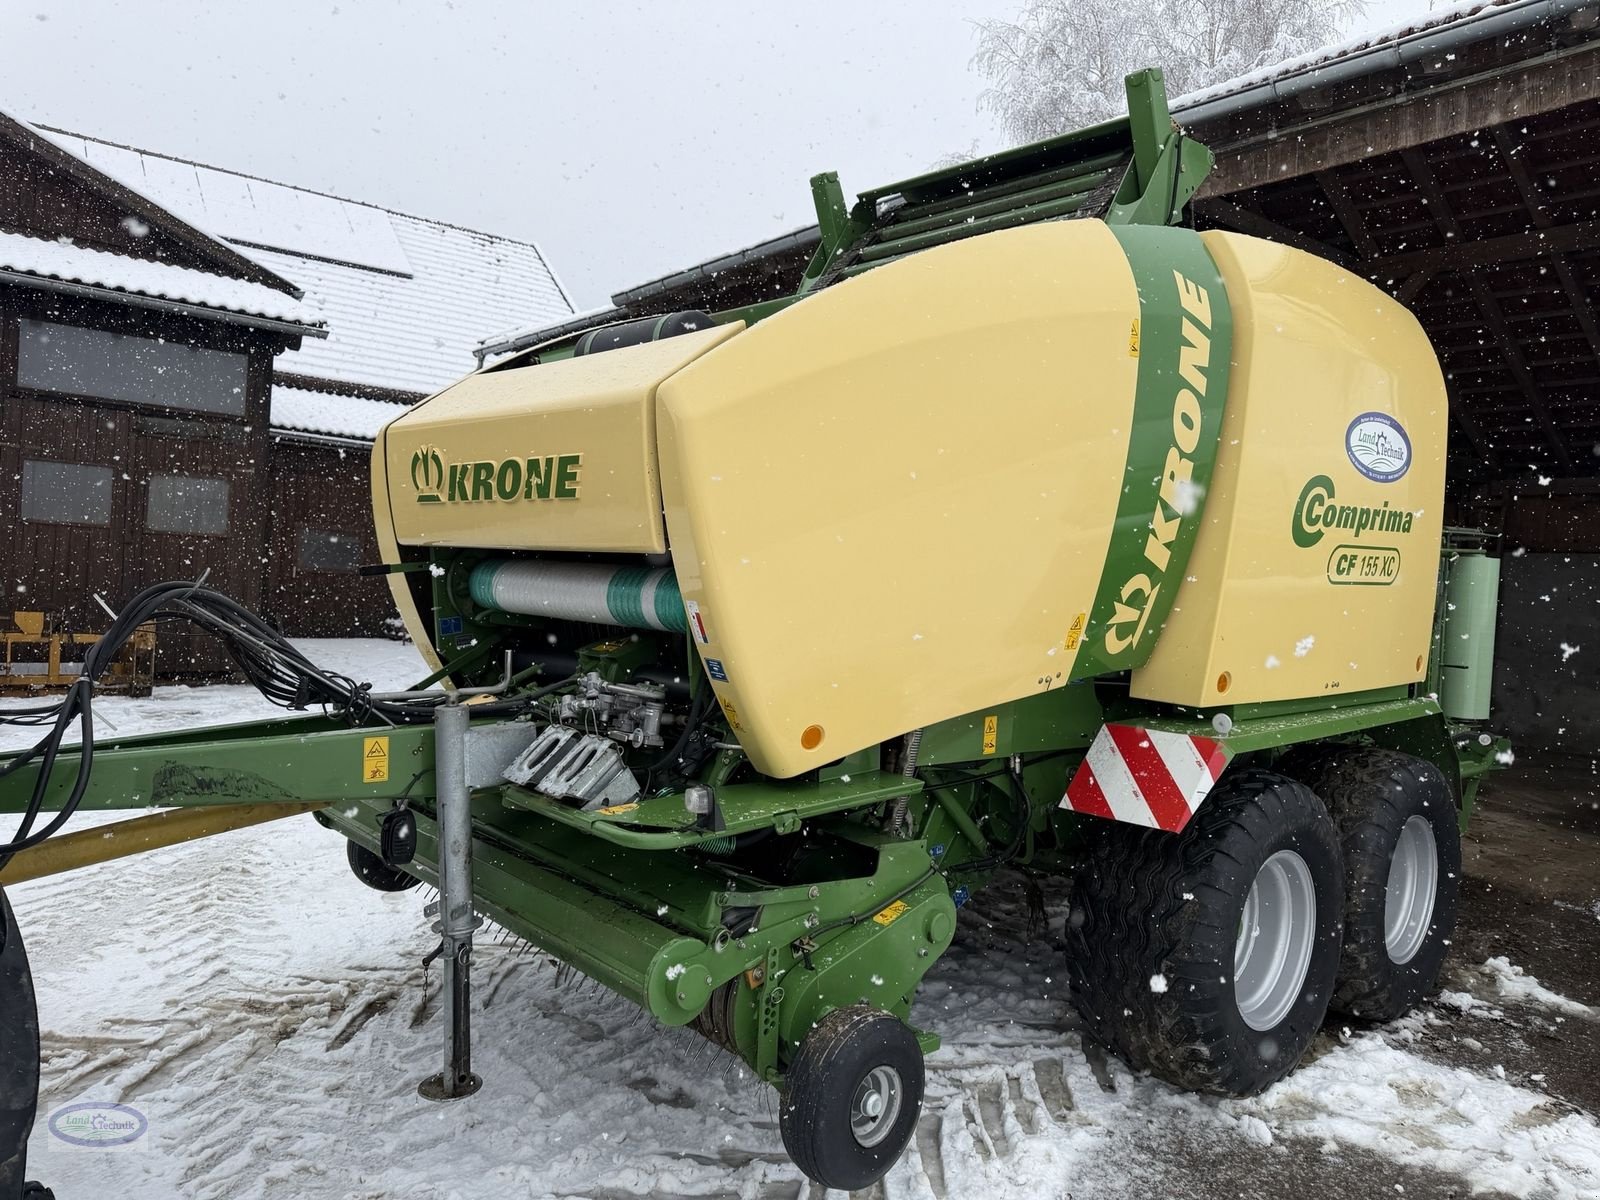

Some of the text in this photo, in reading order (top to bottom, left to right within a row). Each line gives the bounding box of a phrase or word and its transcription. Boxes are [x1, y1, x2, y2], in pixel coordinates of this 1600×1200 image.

[1143, 269, 1212, 573] KRONE
[1358, 428, 1404, 461] Land Technik
[448, 454, 583, 503] KRONE
[1336, 553, 1396, 577] CF 155 XC
